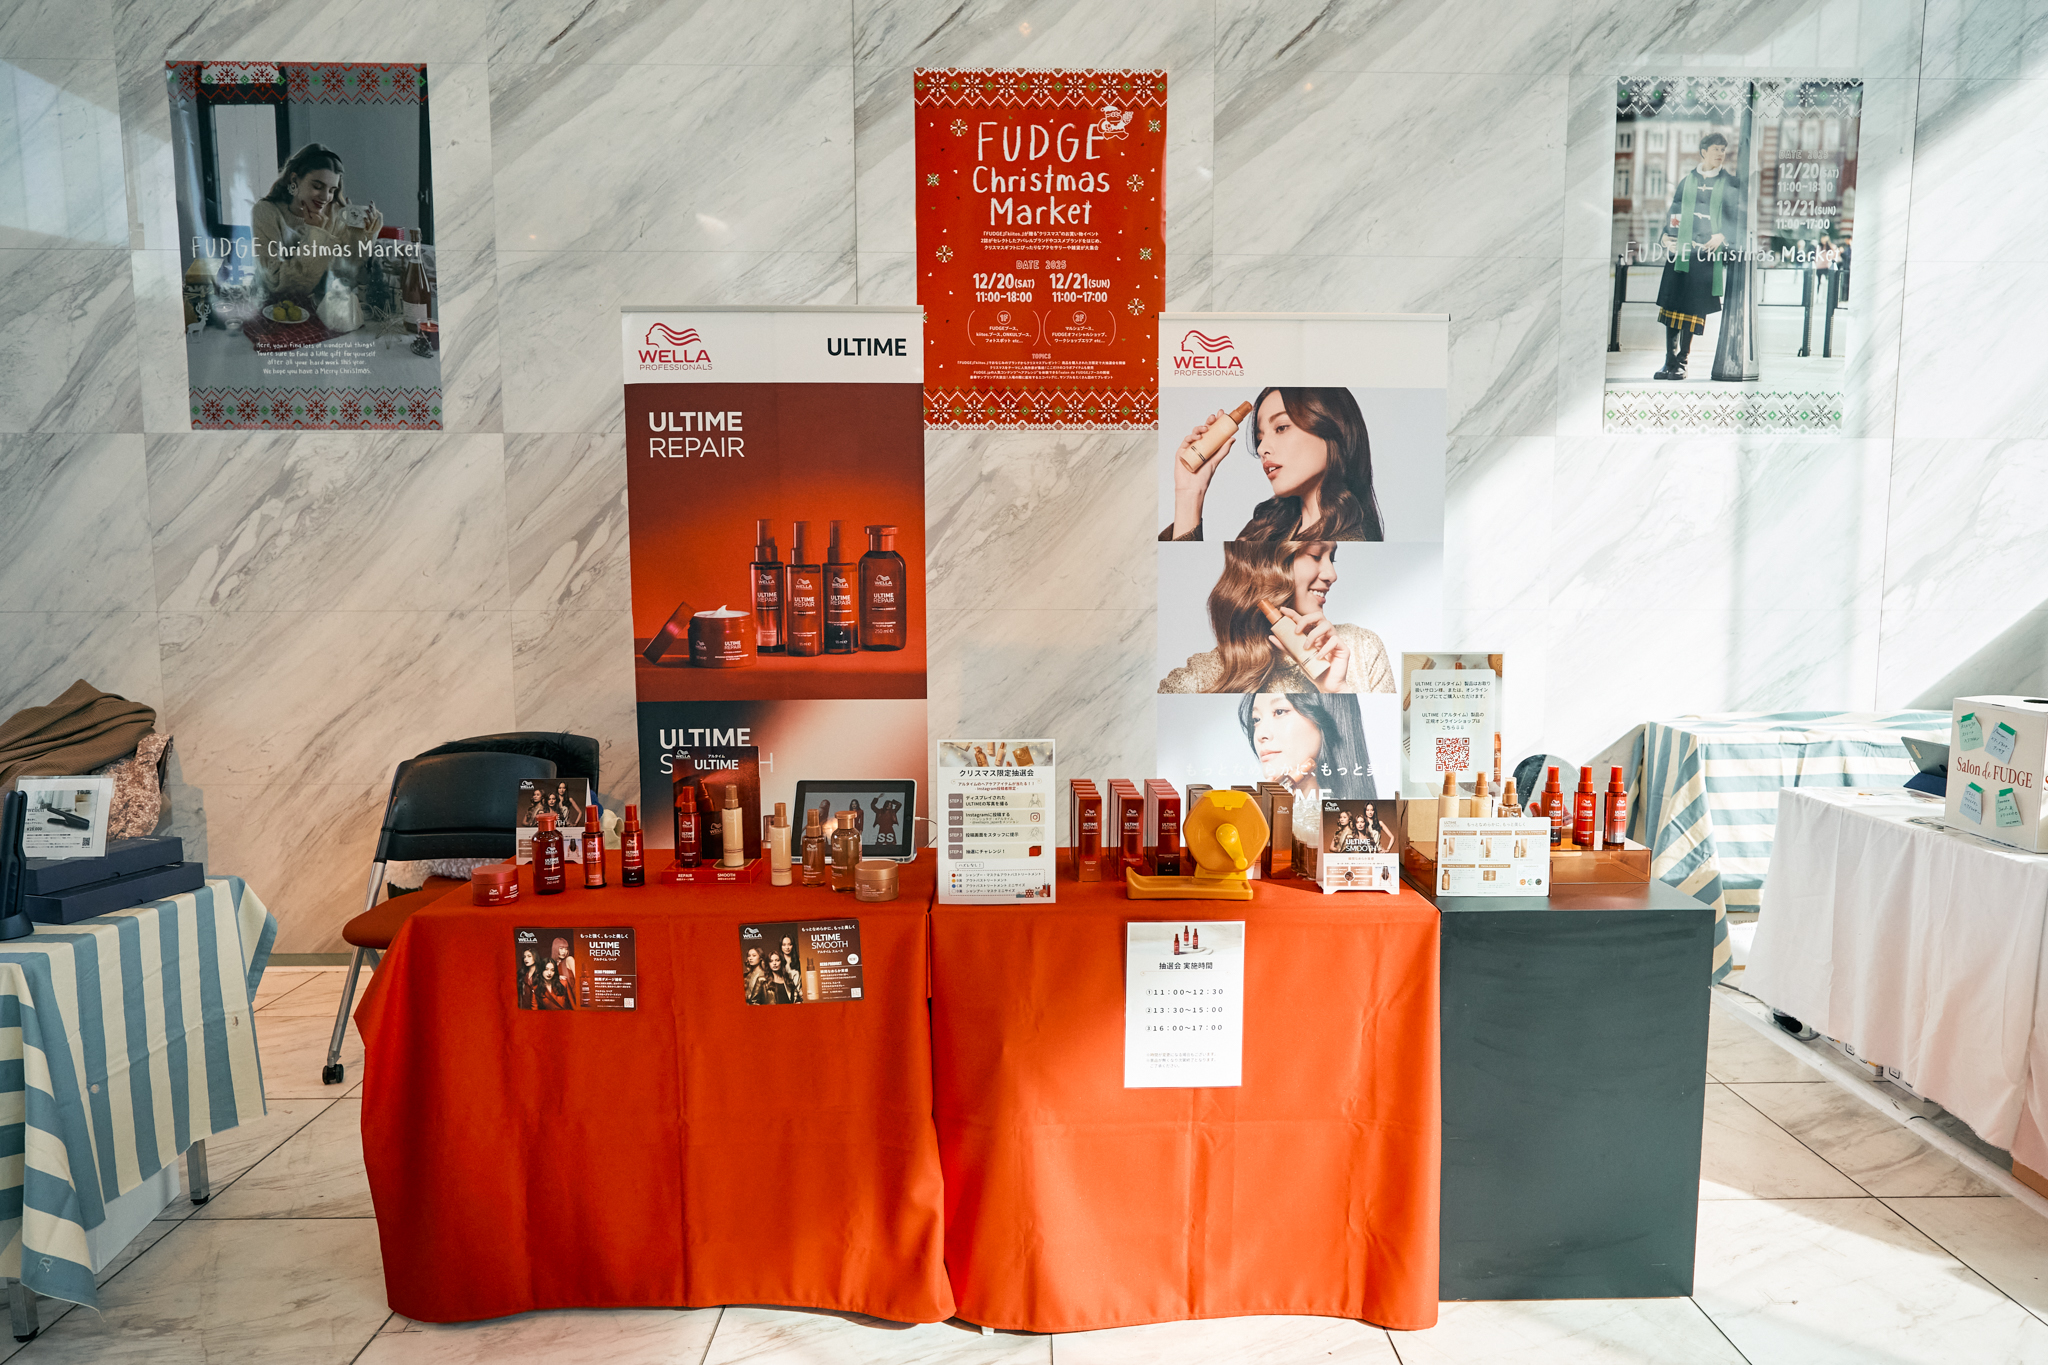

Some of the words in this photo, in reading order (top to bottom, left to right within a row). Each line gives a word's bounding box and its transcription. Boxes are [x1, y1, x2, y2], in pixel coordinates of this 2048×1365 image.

[978, 122, 1104, 162] FUDGE
[973, 165, 1110, 193] Christmas
[1778, 162, 1840, 180] 12/20(SAT)
[990, 196, 1092, 225] Market
[1776, 199, 1837, 216] 12/21(SUN)
[191, 236, 262, 259] FUDGE
[267, 239, 352, 258] Christmas
[357, 239, 421, 258] Market
[1696, 244, 1775, 263] Christmas
[1781, 244, 1841, 263] Market
[1015, 260, 1040, 270] DATE
[1045, 260, 1067, 270] 2025
[972, 272, 1035, 289] 12/20(SAT)
[1049, 272, 1111, 289] 12/21(SUN)
[827, 337, 907, 356] ULTIME
[638, 350, 712, 363] WELLA
[1173, 356, 1244, 368] WELLA
[649, 412, 743, 432] ULTIME
[649, 437, 745, 458] REPAIR
[660, 728, 751, 749] ULTIME
[694, 760, 739, 770] ULTIME
[960, 769, 1034, 777] クリスマス限定抽選会
[1956, 756, 1980, 776] Salon
[1982, 762, 1991, 780] de
[1992, 766, 2032, 788] FUDGE
[811, 933, 840, 941] ULTIME
[812, 941, 848, 949] SMOOTH
